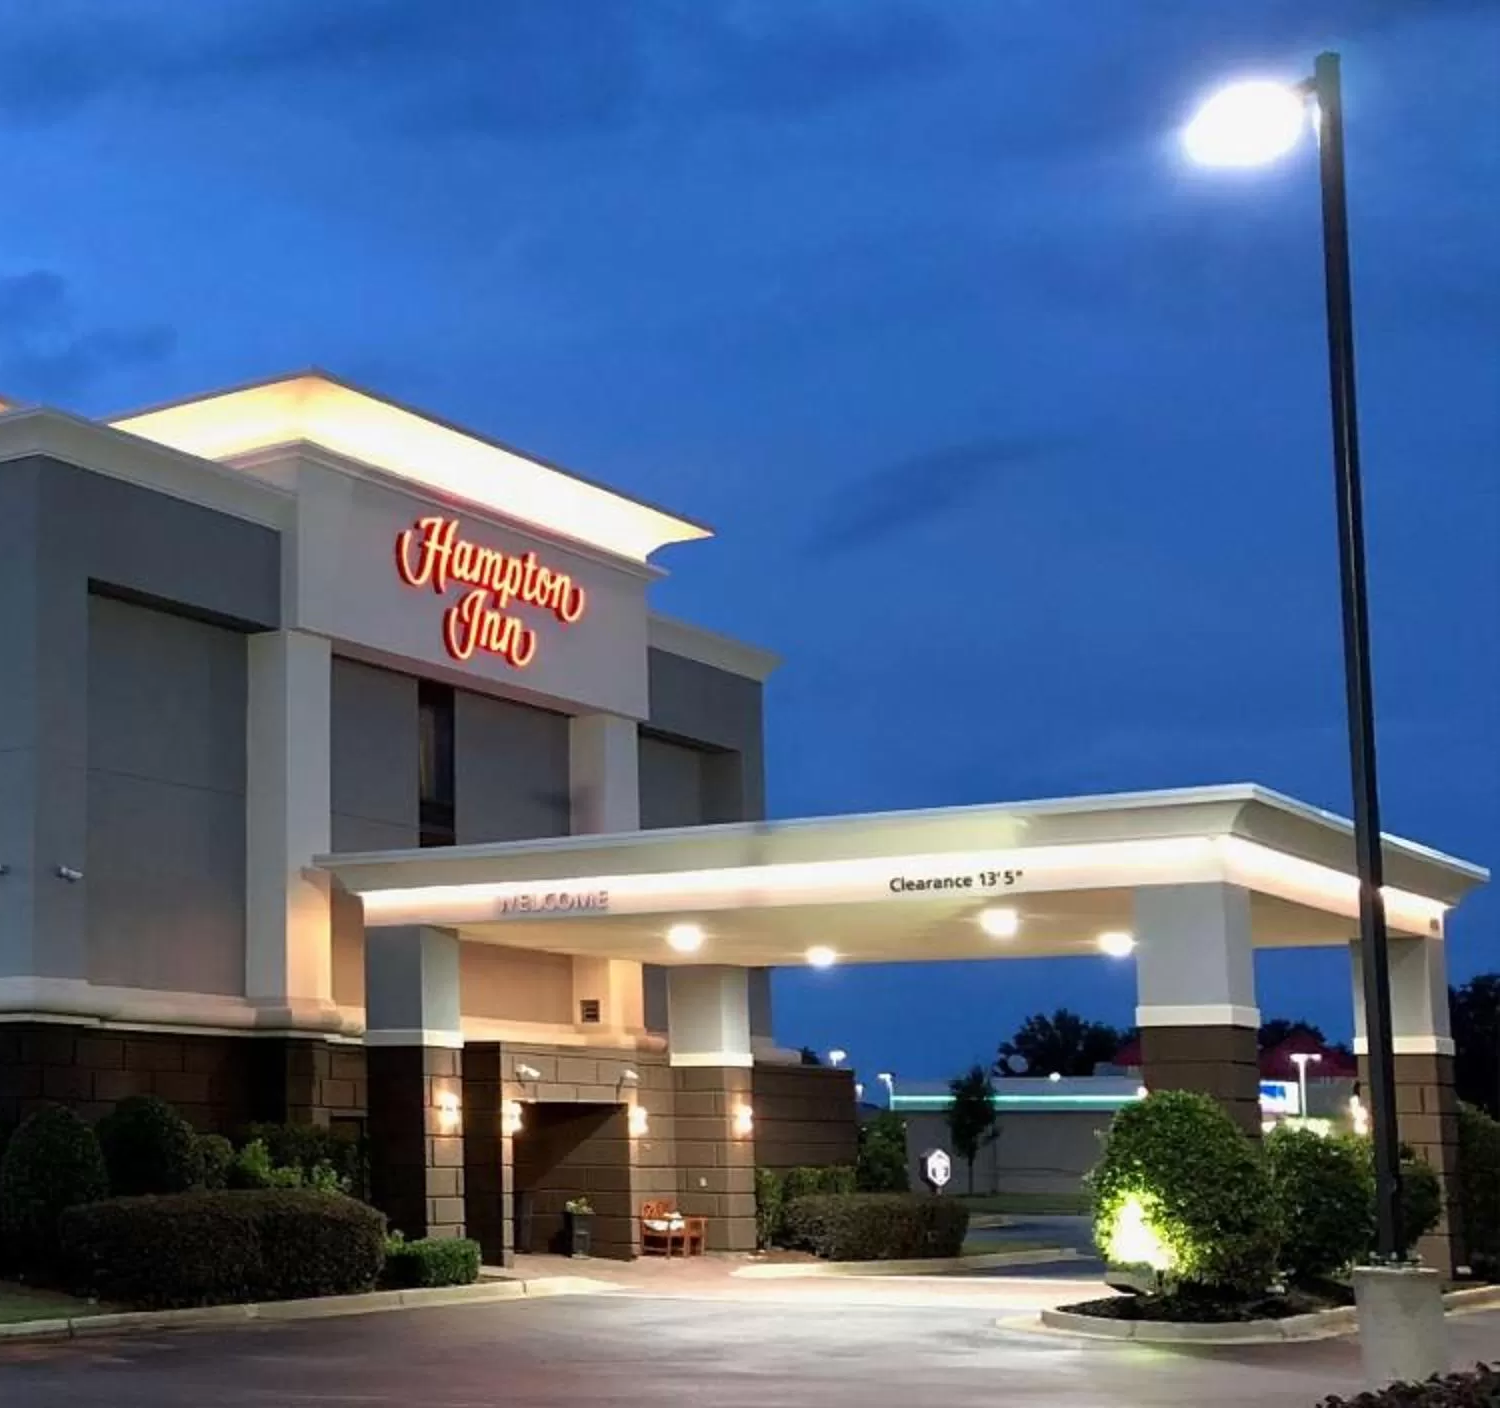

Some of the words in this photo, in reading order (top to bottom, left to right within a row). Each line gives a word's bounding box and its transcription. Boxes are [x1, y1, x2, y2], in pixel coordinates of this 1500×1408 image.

[395, 516, 585, 623] Hampton
[443, 588, 536, 667] Inn
[495, 890, 609, 913] WELCOME
[889, 876, 973, 893] Clearance
